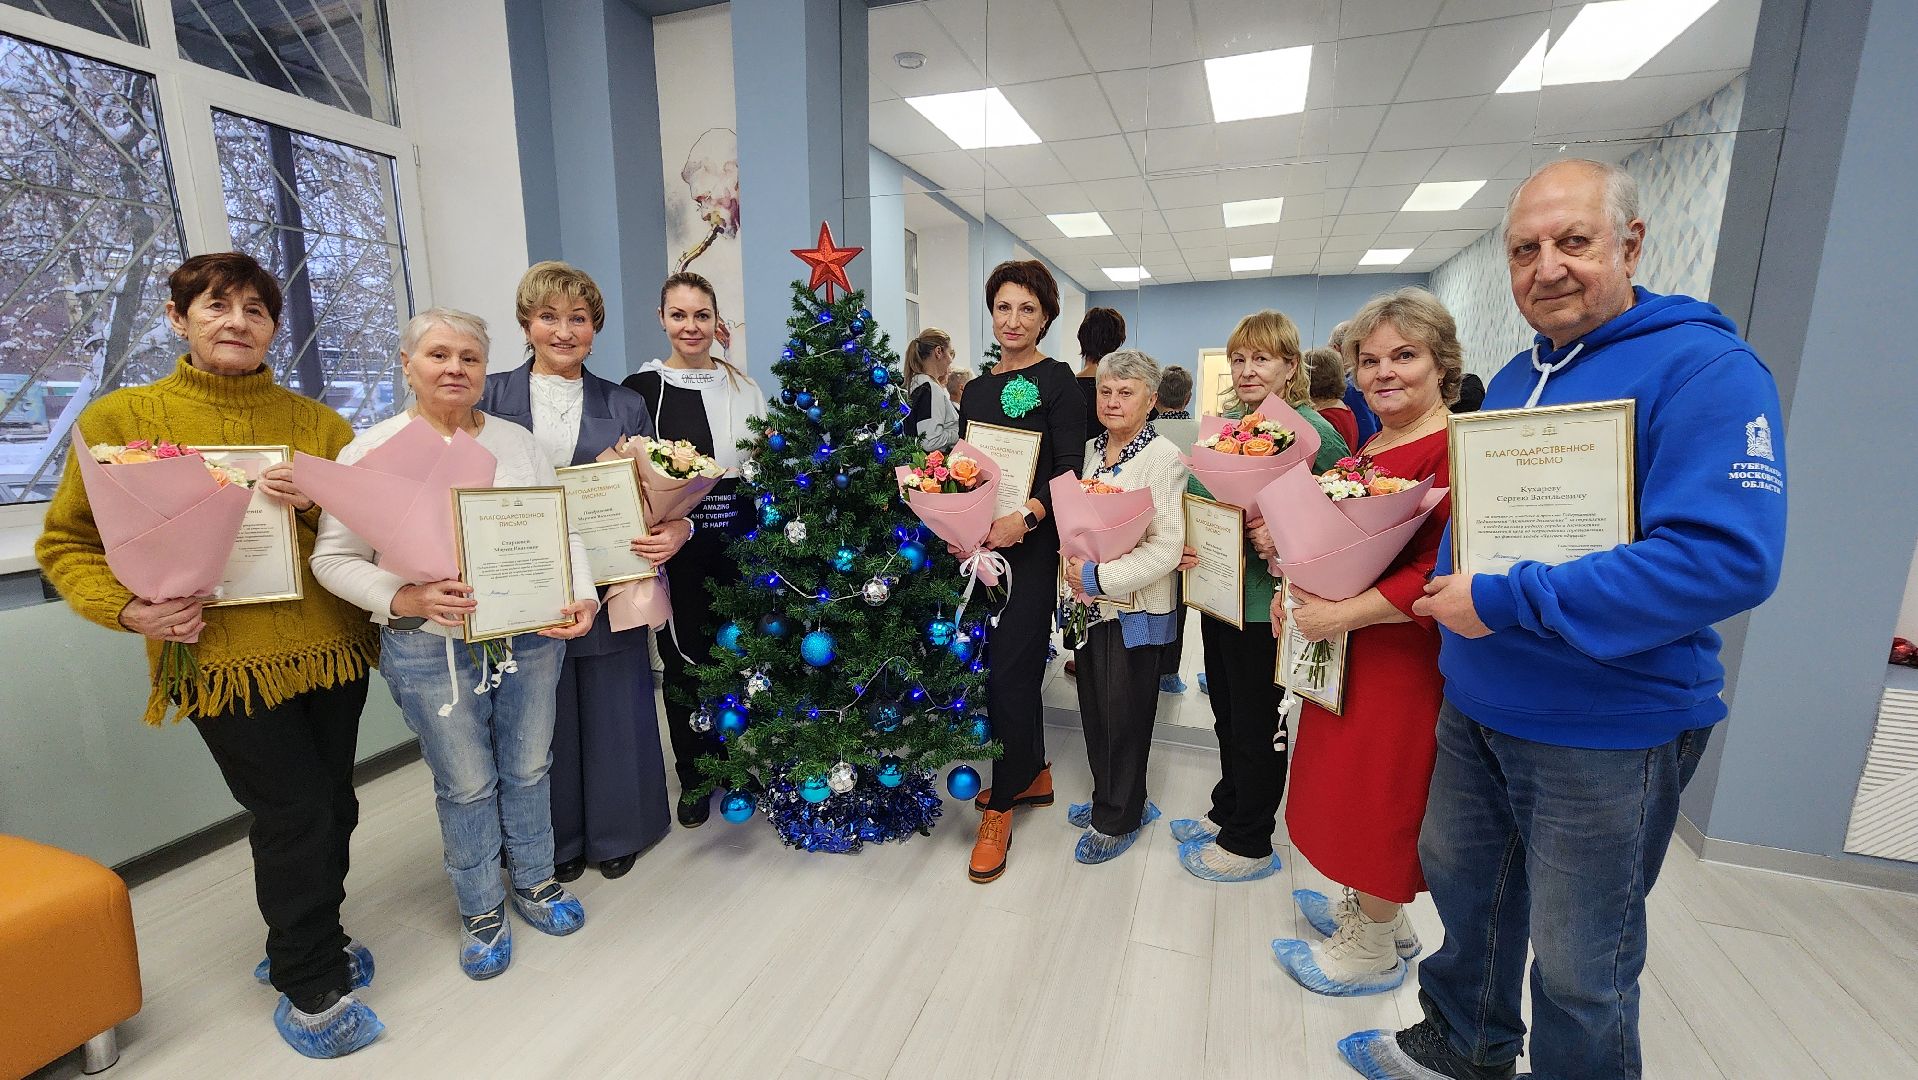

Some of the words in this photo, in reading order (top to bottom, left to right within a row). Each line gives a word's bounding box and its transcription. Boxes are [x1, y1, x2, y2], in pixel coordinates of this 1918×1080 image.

[1485, 443, 1595, 458] БЛАГОДАРСТВЕННОЕ
[1516, 456, 1563, 467] ПИСЬМО
[702, 503, 730, 511] AMAZING
[479, 512, 545, 521] БЛАГОДАРСТВЕННОЕ
[705, 510, 739, 520] EVERYBODY
